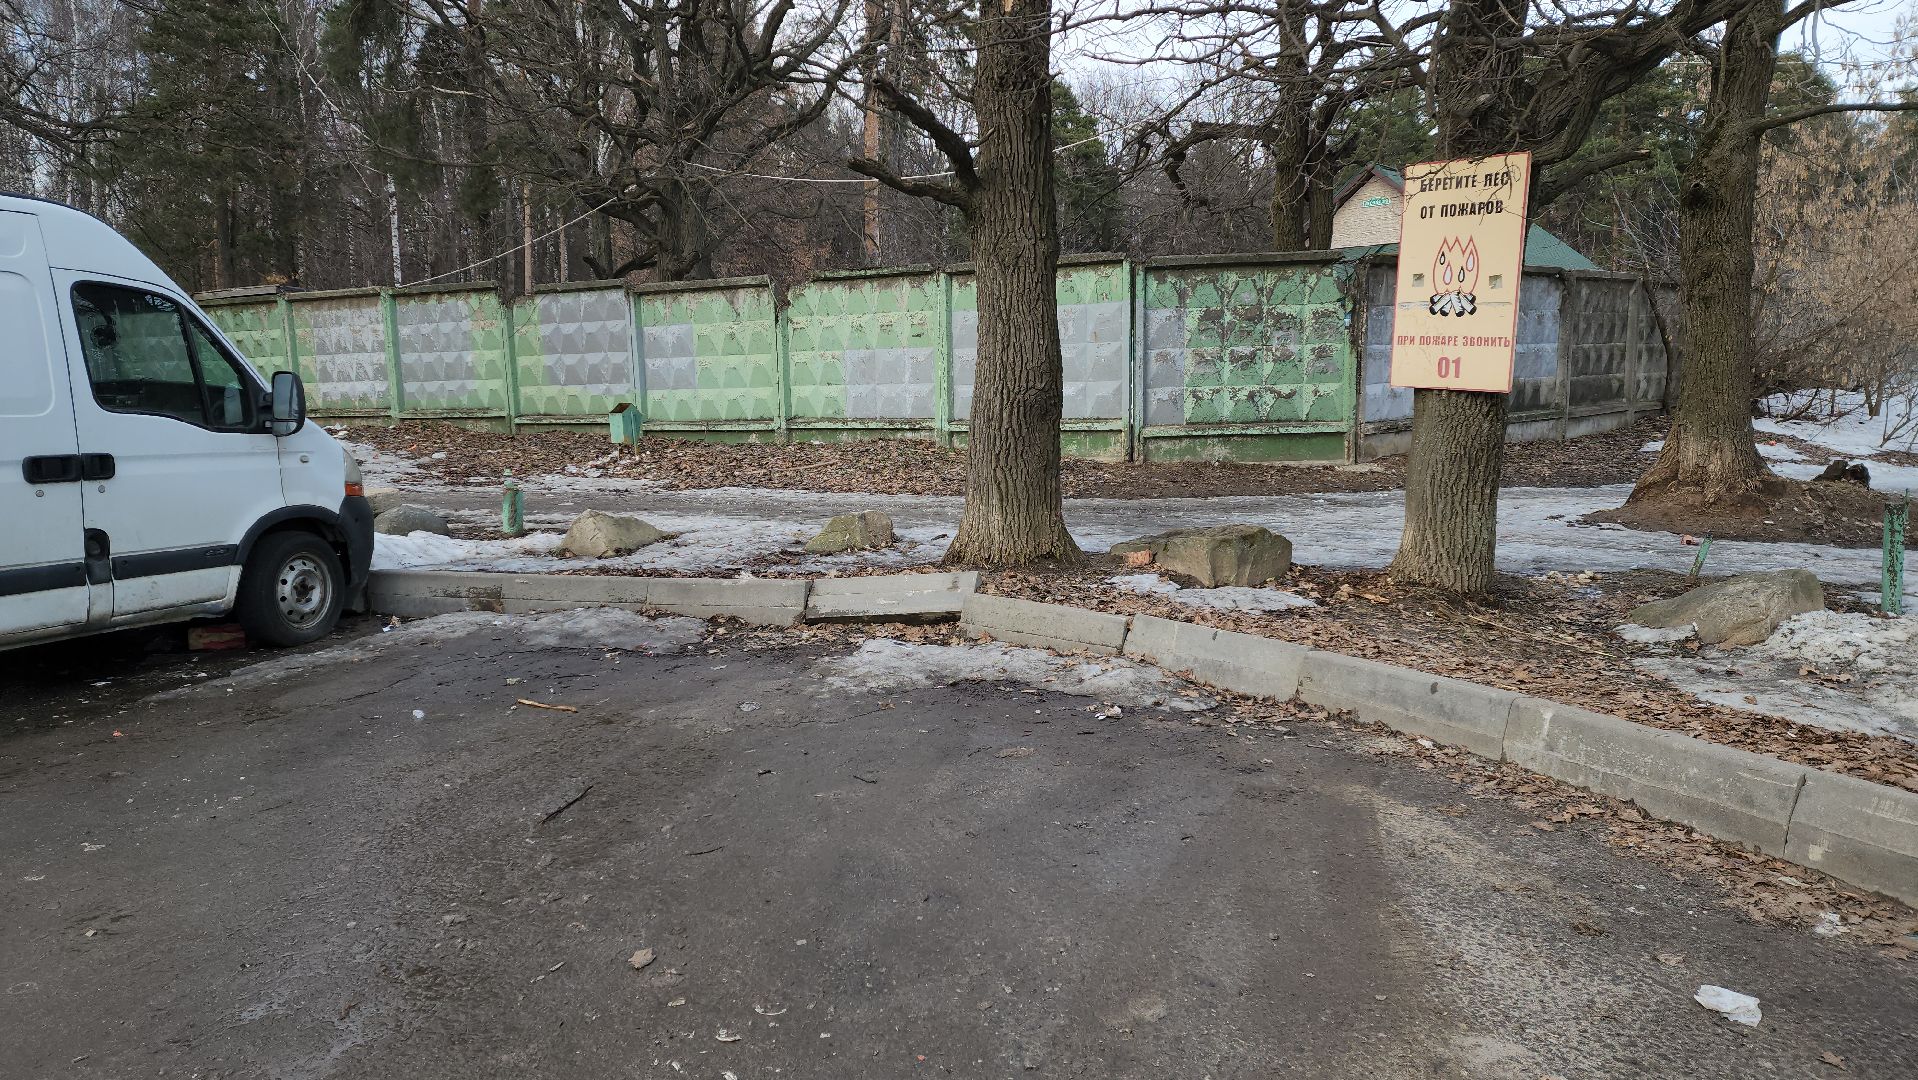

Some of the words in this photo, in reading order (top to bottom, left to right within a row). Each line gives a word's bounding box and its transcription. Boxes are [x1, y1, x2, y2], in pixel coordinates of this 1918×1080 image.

[1420, 175, 1477, 192] БЕРЕГИТЕ
[1484, 171, 1509, 188] ЛЕС
[1420, 205, 1435, 219] ОТ
[1440, 200, 1504, 218] ПОЖАРОВ
[1397, 336, 1416, 346] ПРИ
[1419, 336, 1459, 347] ПОЖАРЕ
[1462, 336, 1511, 348] ЗВОНИТЬ
[1437, 356, 1462, 379] 01
